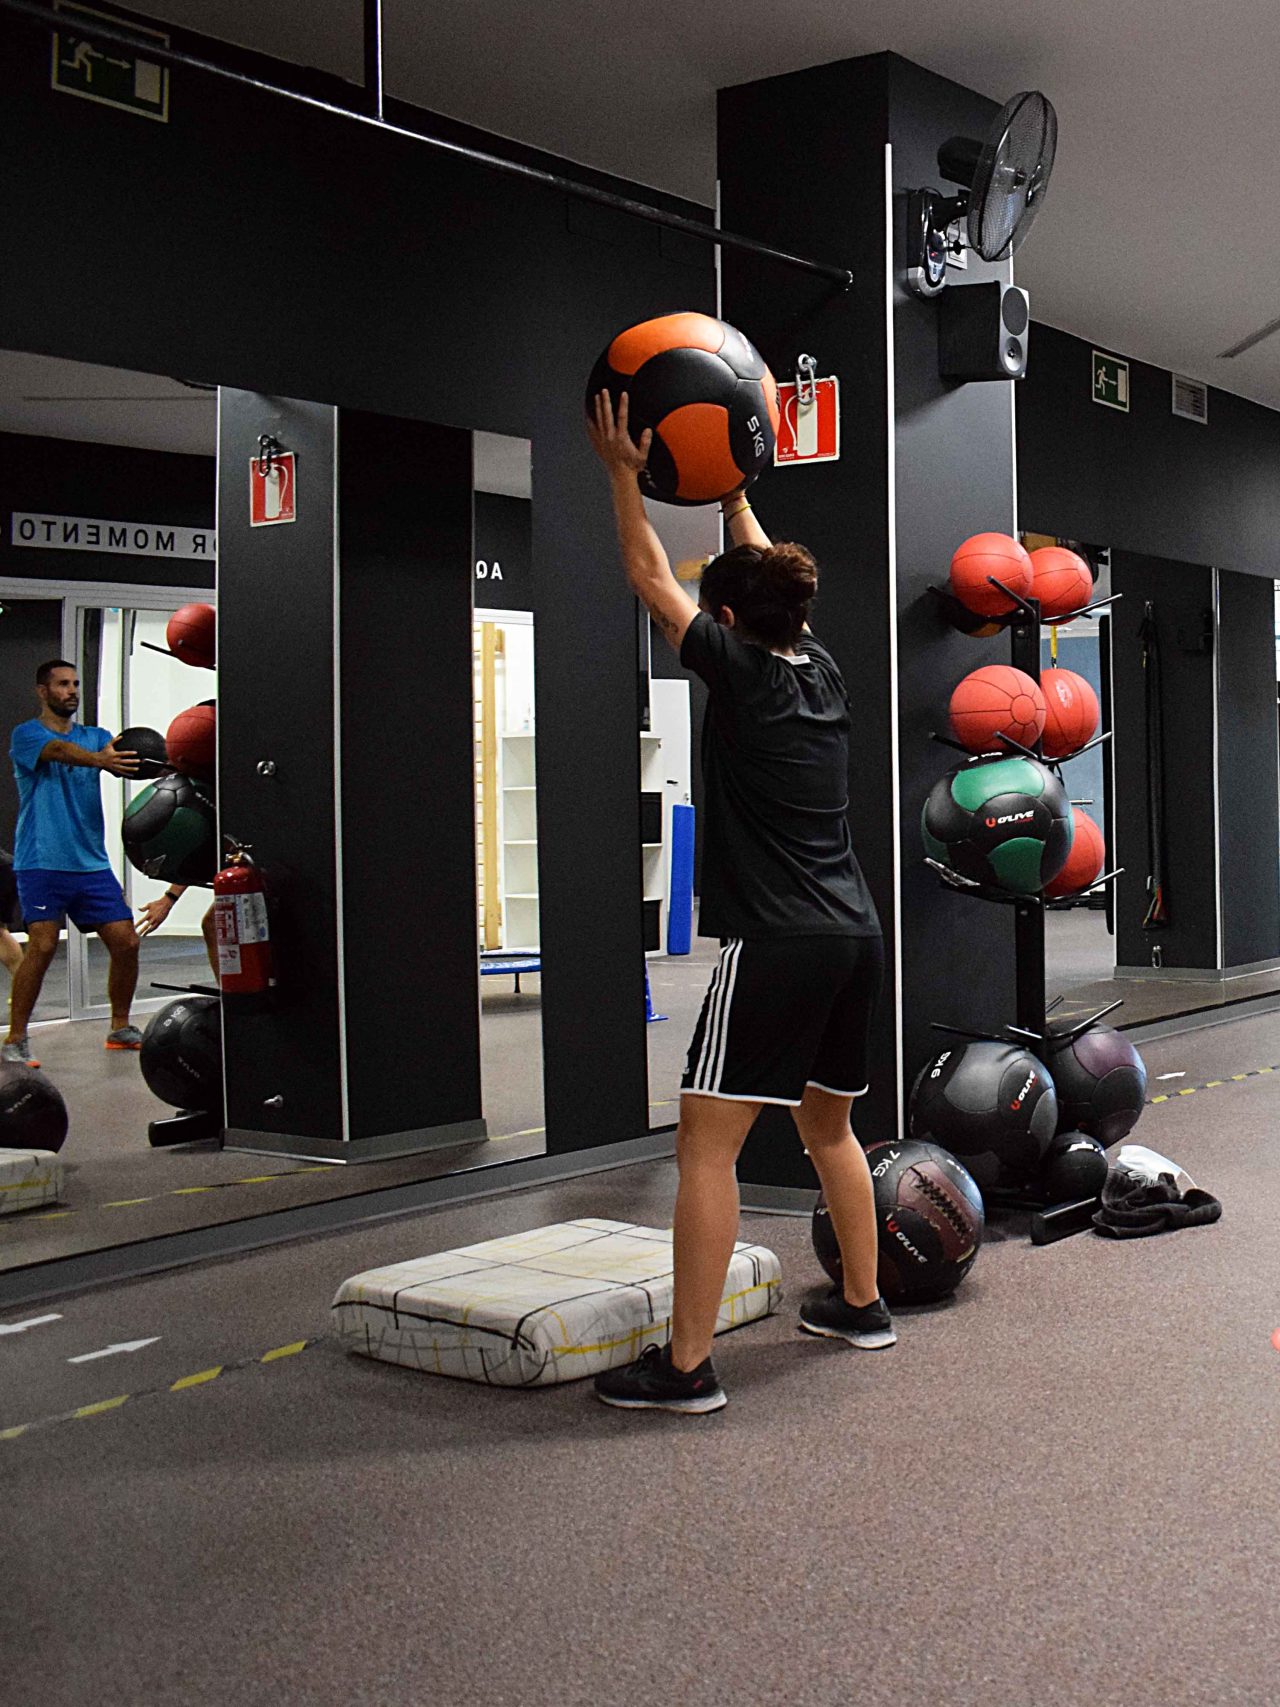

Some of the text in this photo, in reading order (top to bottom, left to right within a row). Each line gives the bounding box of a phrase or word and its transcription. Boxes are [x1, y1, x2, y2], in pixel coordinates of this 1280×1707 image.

[746, 415, 765, 457] 5 KG
[872, 1150, 901, 1178] 7 KG
